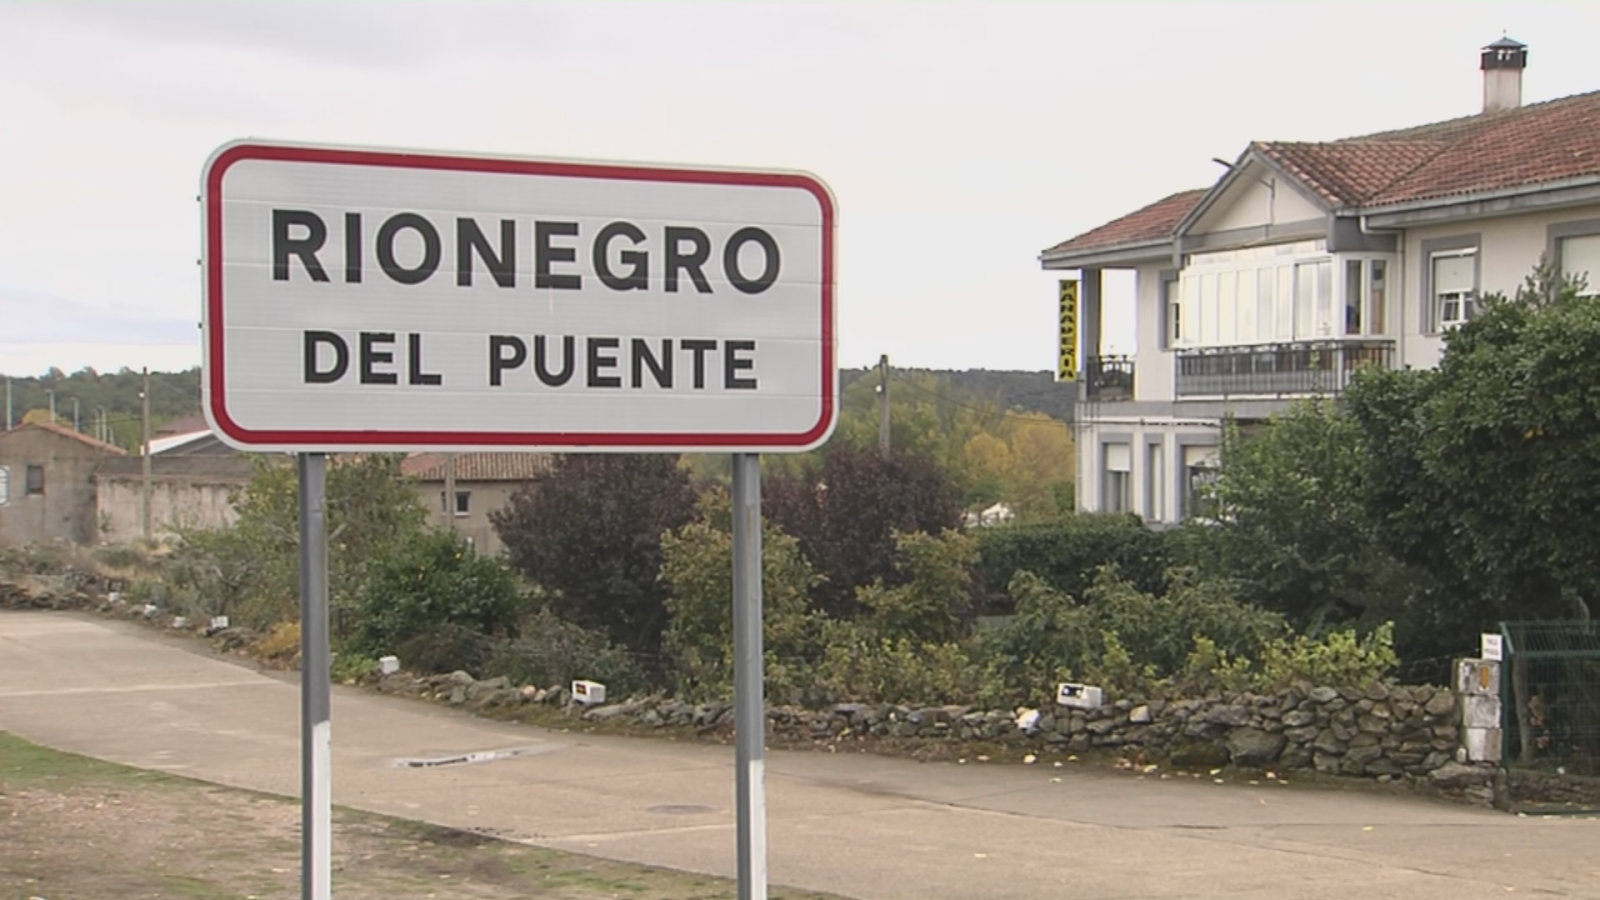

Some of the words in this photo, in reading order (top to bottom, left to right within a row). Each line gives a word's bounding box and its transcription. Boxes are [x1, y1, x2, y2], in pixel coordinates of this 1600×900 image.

[272, 208, 781, 295] RIONEGRO
[304, 330, 442, 386] DEL
[490, 334, 758, 390] PUENTE
